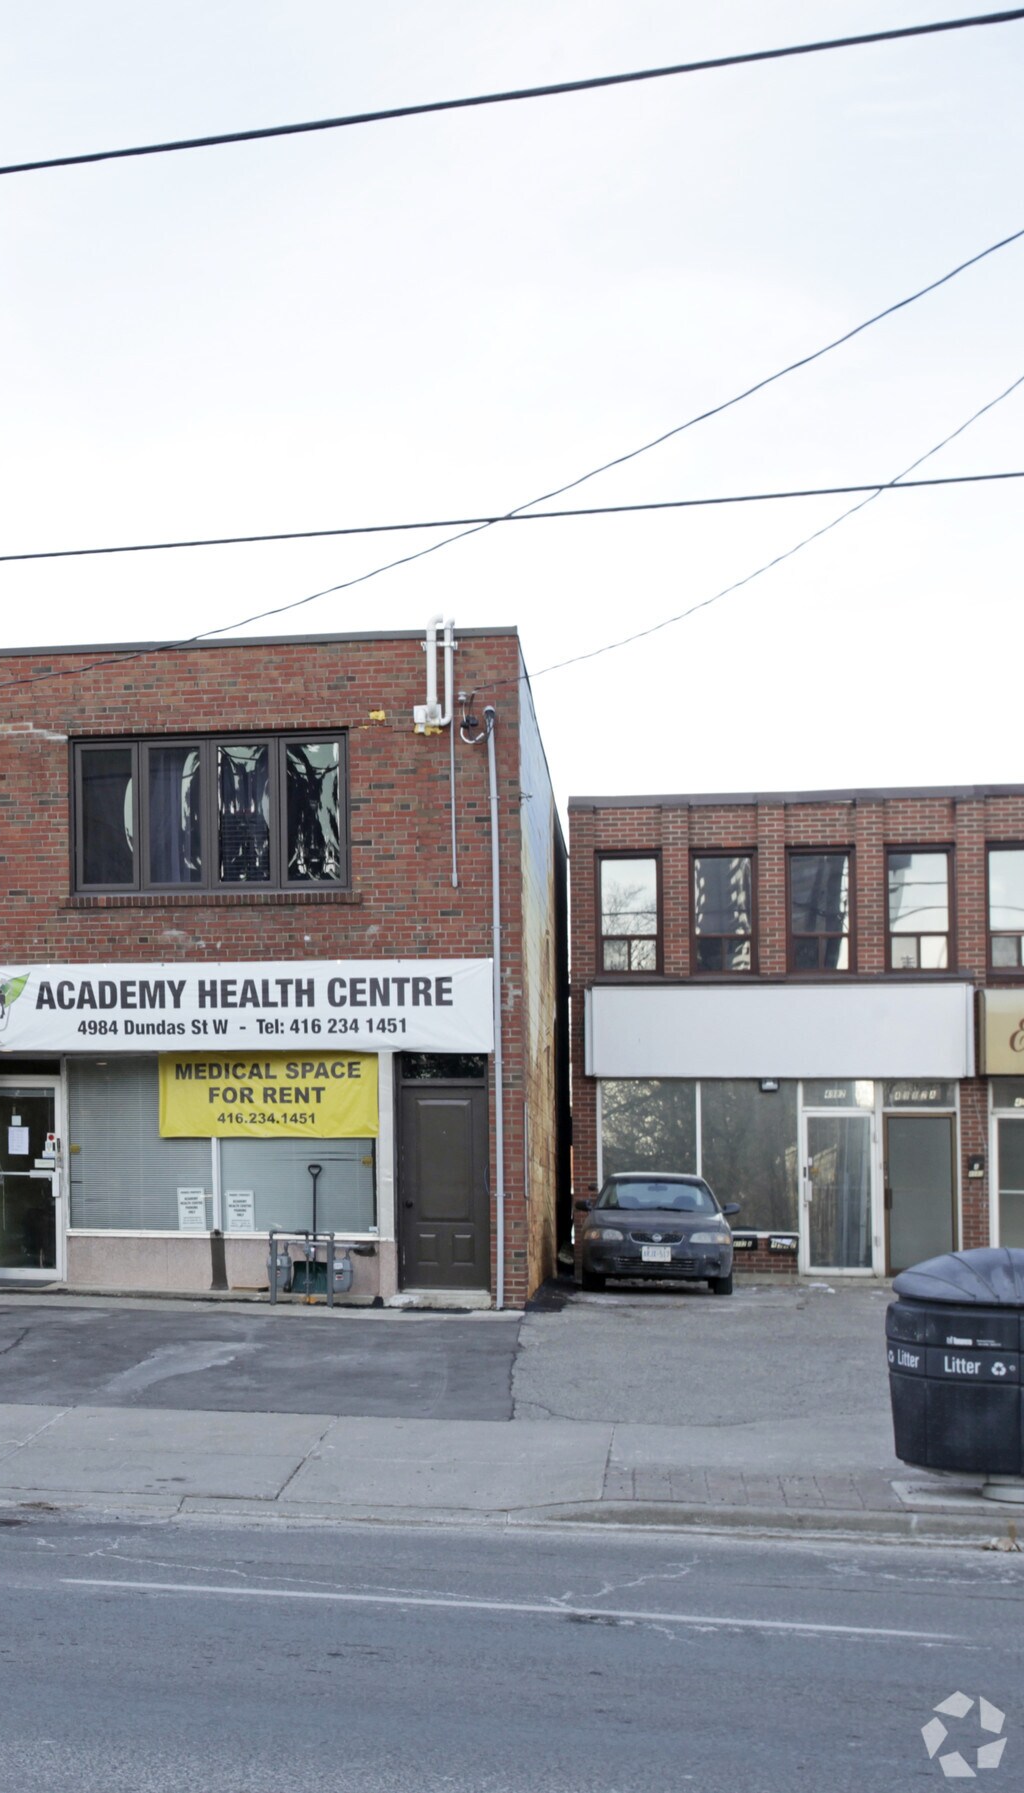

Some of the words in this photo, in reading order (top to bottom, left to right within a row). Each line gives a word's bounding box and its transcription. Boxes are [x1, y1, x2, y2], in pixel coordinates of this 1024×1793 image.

[35, 980, 186, 1010] ACADEMY
[198, 978, 315, 1009] HEALTH
[327, 976, 454, 1008] CENTRE
[77, 1020, 119, 1036] 4984
[123, 1019, 186, 1036] Dundas
[191, 1019, 209, 1035] St
[211, 1019, 229, 1035] W
[256, 1018, 286, 1035] Tel:
[289, 1018, 321, 1034] 416
[327, 1018, 360, 1034] 234
[365, 1018, 408, 1034] 1451
[174, 1062, 278, 1082] MEDICAL
[285, 1061, 362, 1080] SPACE
[208, 1086, 255, 1104] FOR
[262, 1086, 326, 1104] RENT
[217, 1112, 317, 1125] 416.234.1451
[897, 1349, 920, 1369] Litter
[944, 1355, 981, 1375] Litter
